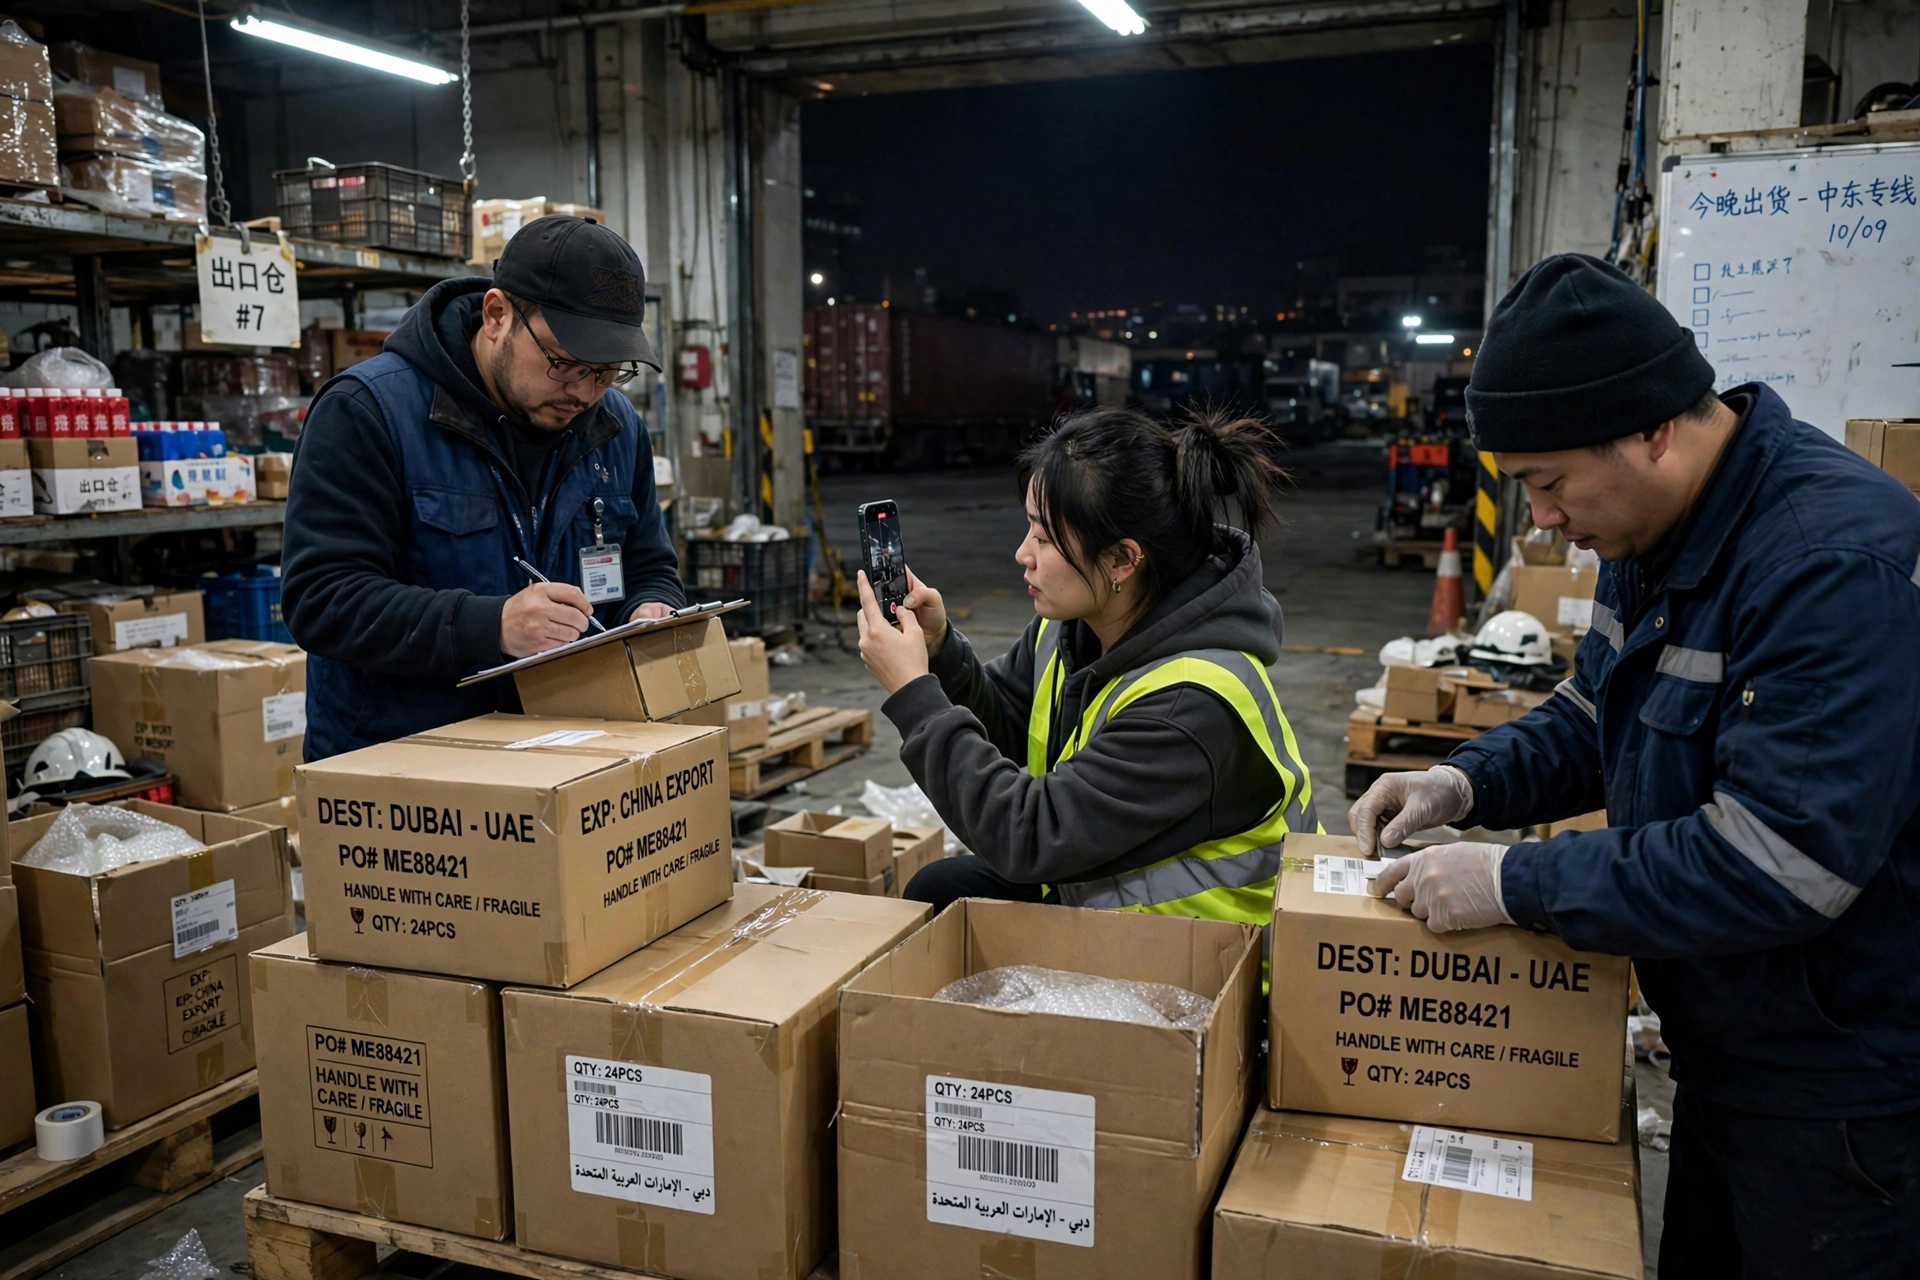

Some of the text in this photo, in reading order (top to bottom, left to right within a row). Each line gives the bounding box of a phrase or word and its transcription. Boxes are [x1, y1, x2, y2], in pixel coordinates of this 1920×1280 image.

[1688, 185, 1791, 220] 今晚出货
[1818, 175, 1916, 212] 中东专线
[1829, 216, 1886, 248] 10/09
[212, 257, 285, 294] 出口仓
[237, 305, 264, 330] #7
[581, 759, 714, 835] EXP: CHINA EXPORT
[318, 798, 382, 829] DEST:
[390, 804, 462, 836] DUBAI
[485, 812, 535, 843] UAE
[607, 818, 688, 873] PO# ME88421
[339, 844, 467, 878] PO# ME88421
[604, 877, 641, 907] HANDLE
[640, 868, 661, 888] WITH
[664, 856, 685, 878] CARE
[690, 839, 719, 862] FRAGILE
[344, 883, 396, 902] HANDLE
[399, 889, 431, 906] WITH
[436, 893, 472, 910] CARE
[484, 898, 540, 917] FRAGILE
[372, 915, 455, 939] QTY: 24PCS
[1318, 942, 1399, 976] DEST:
[1411, 950, 1500, 985] DUBAI
[1529, 959, 1591, 993] UAE
[1340, 991, 1510, 1029] PO# ME88421
[315, 1034, 421, 1066] PO# ME88421
[1336, 1031, 1400, 1051] HANDLE
[1406, 1038, 1445, 1055] WITH
[1451, 1042, 1495, 1060] CARE
[1510, 1047, 1579, 1068] FRAGILE
[316, 1066, 419, 1098] HANDLE WITH
[574, 1062, 642, 1082] QTY: 24PCS
[1368, 1065, 1470, 1090] QTY: 24PCS
[317, 1088, 357, 1109] CARE
[369, 1097, 423, 1120] FRAGILE
[574, 1094, 593, 1106] QTY:
[935, 1082, 1012, 1104] QTY: 24PCS
[934, 1117, 955, 1128] QTY:
[576, 1165, 608, 1179] المتحدة
[612, 1169, 641, 1187] العربية
[645, 1177, 681, 1196] الإمارات
[693, 1189, 710, 1202] دبي
[933, 1193, 970, 1209] المتحدة
[975, 1198, 1008, 1217] العربية
[1013, 1206, 1055, 1227] الإمارات
[1069, 1219, 1089, 1233] دبي
